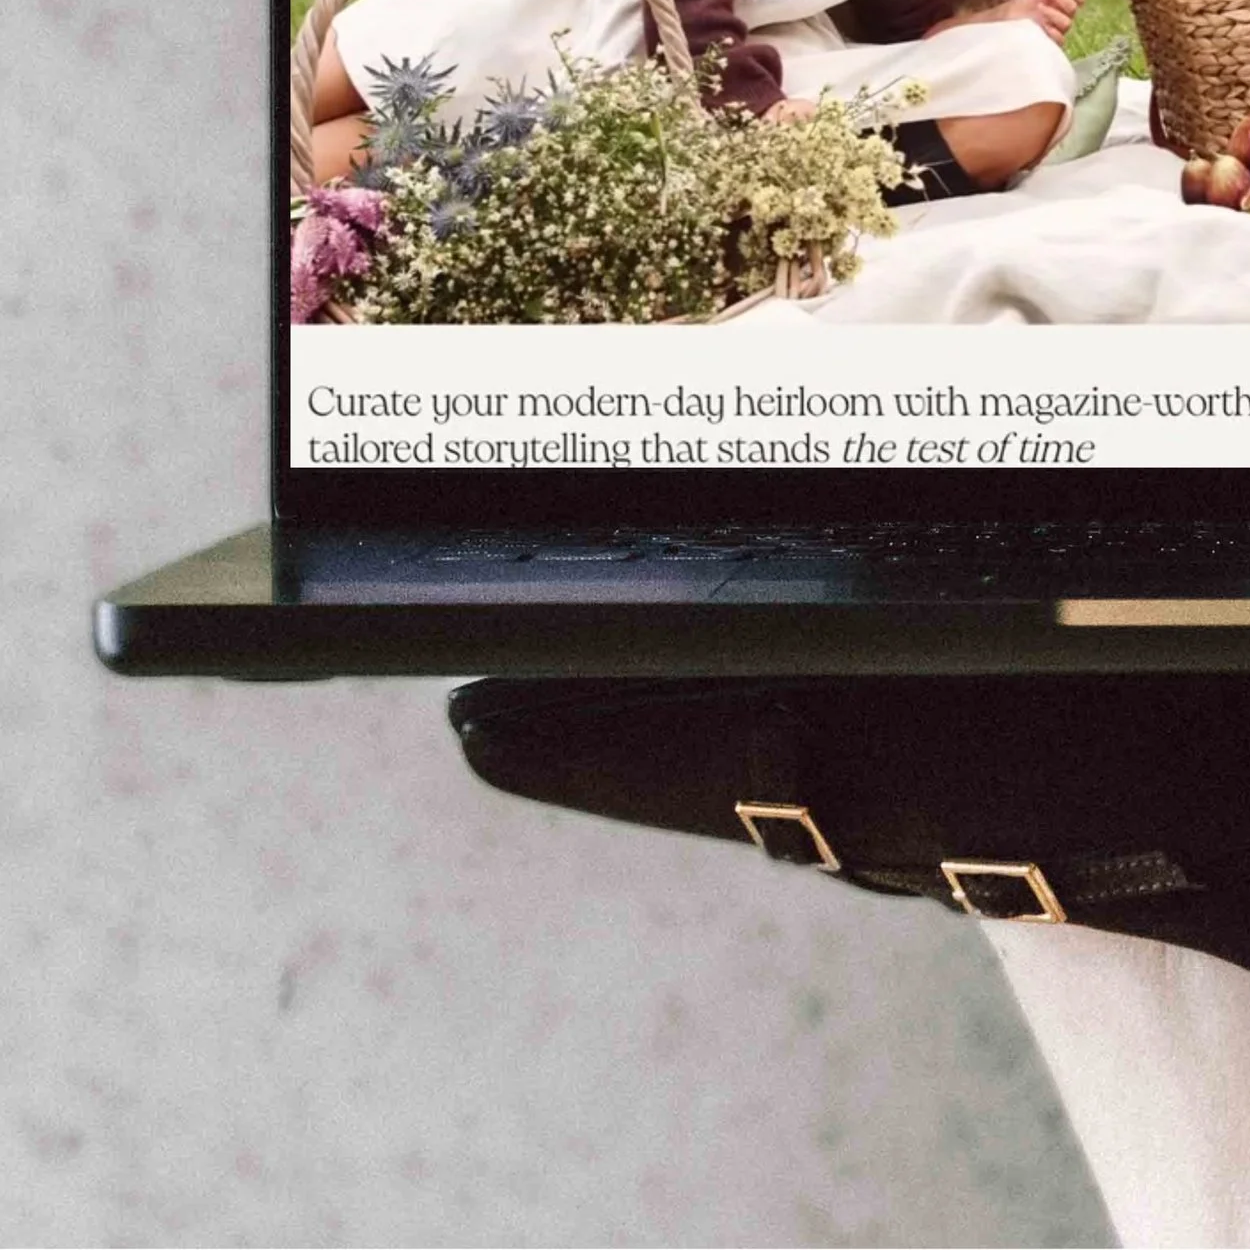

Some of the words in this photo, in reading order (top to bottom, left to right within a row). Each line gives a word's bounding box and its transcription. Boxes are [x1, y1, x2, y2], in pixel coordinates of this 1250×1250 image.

[307, 386, 421, 417] Curate
[431, 393, 509, 425] your
[517, 385, 725, 425] modern-day
[734, 385, 885, 417] heirloom
[893, 384, 971, 417] with
[308, 432, 435, 464] tailored
[444, 432, 632, 467] storytelling
[640, 432, 709, 464] that
[717, 432, 831, 464] stands
[843, 432, 897, 464] the
[906, 435, 970, 464] test
[977, 431, 1018, 464] of
[1018, 432, 1096, 464] time
